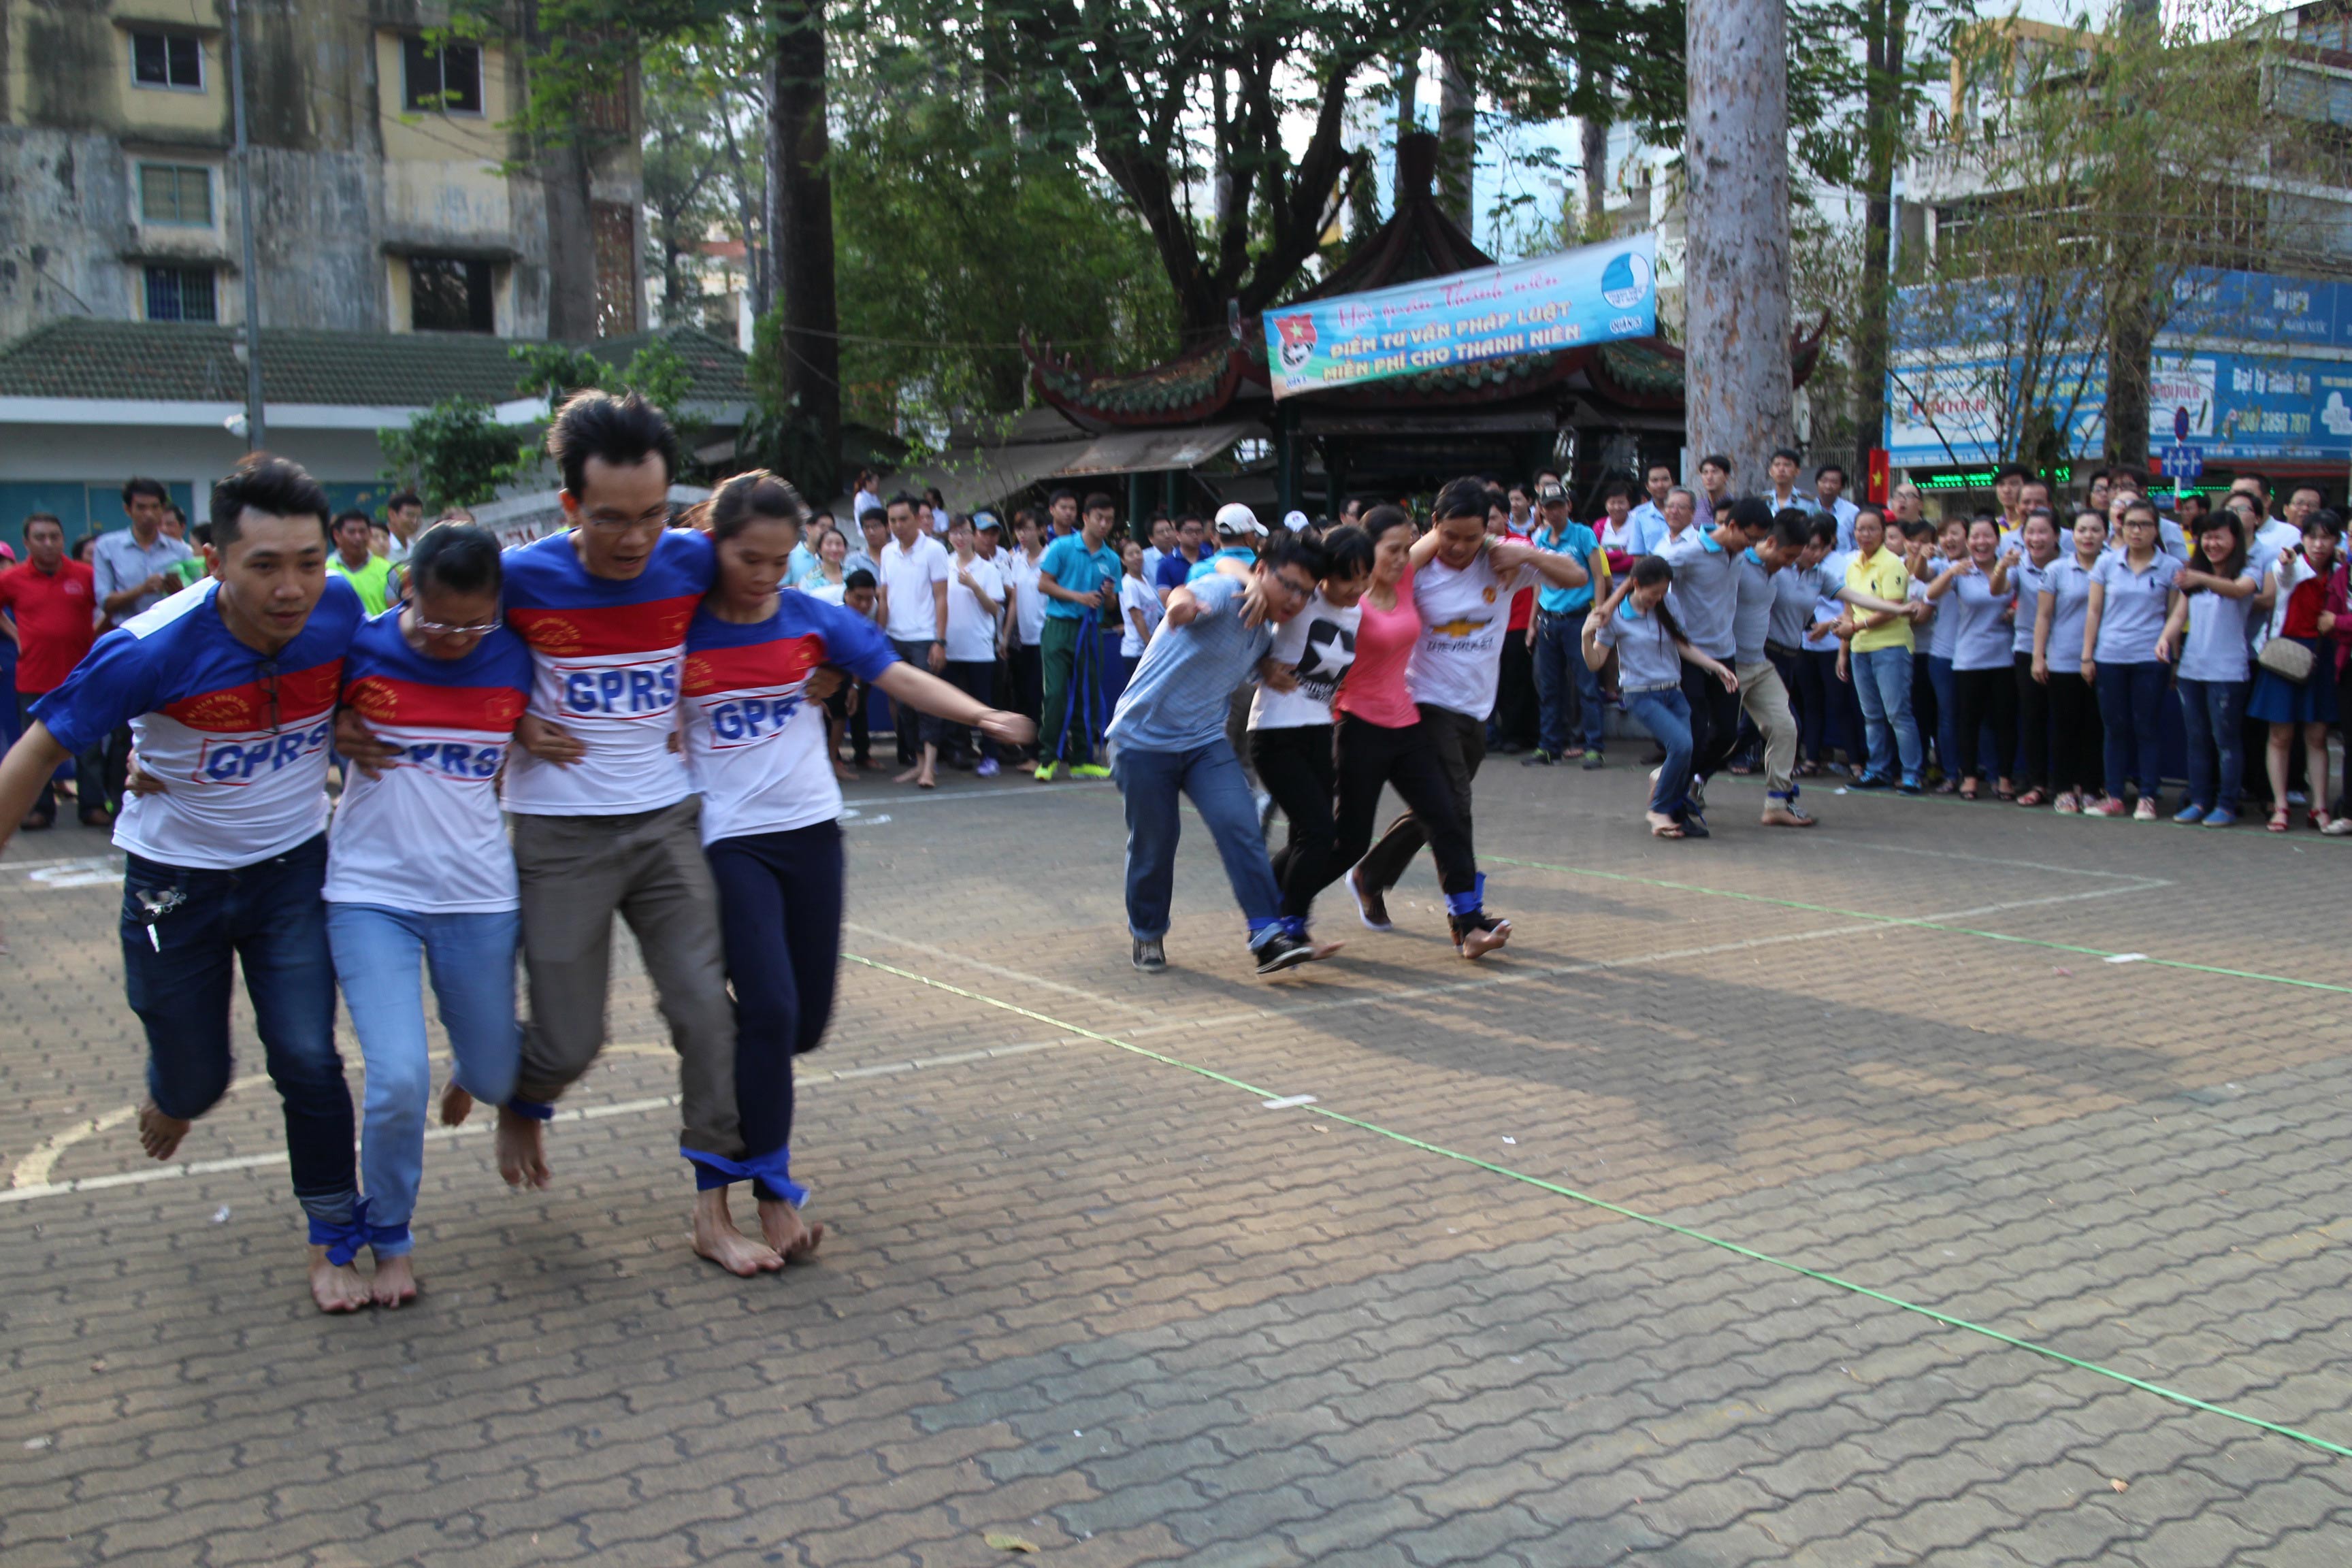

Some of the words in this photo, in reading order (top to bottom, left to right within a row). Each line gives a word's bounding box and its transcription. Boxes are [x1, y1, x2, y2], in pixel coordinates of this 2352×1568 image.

[1456, 312, 1511, 336] PHÁP
[1517, 300, 1573, 325] LUẬT
[1374, 350, 1407, 374] PHÍ
[1410, 346, 1450, 367] CHO
[1454, 333, 1524, 359] THANH
[1530, 324, 1580, 347] NIÊN
[568, 663, 676, 713] GPRS
[713, 695, 804, 740] GPR
[206, 721, 329, 781] GPRS
[380, 740, 500, 777] PRS
